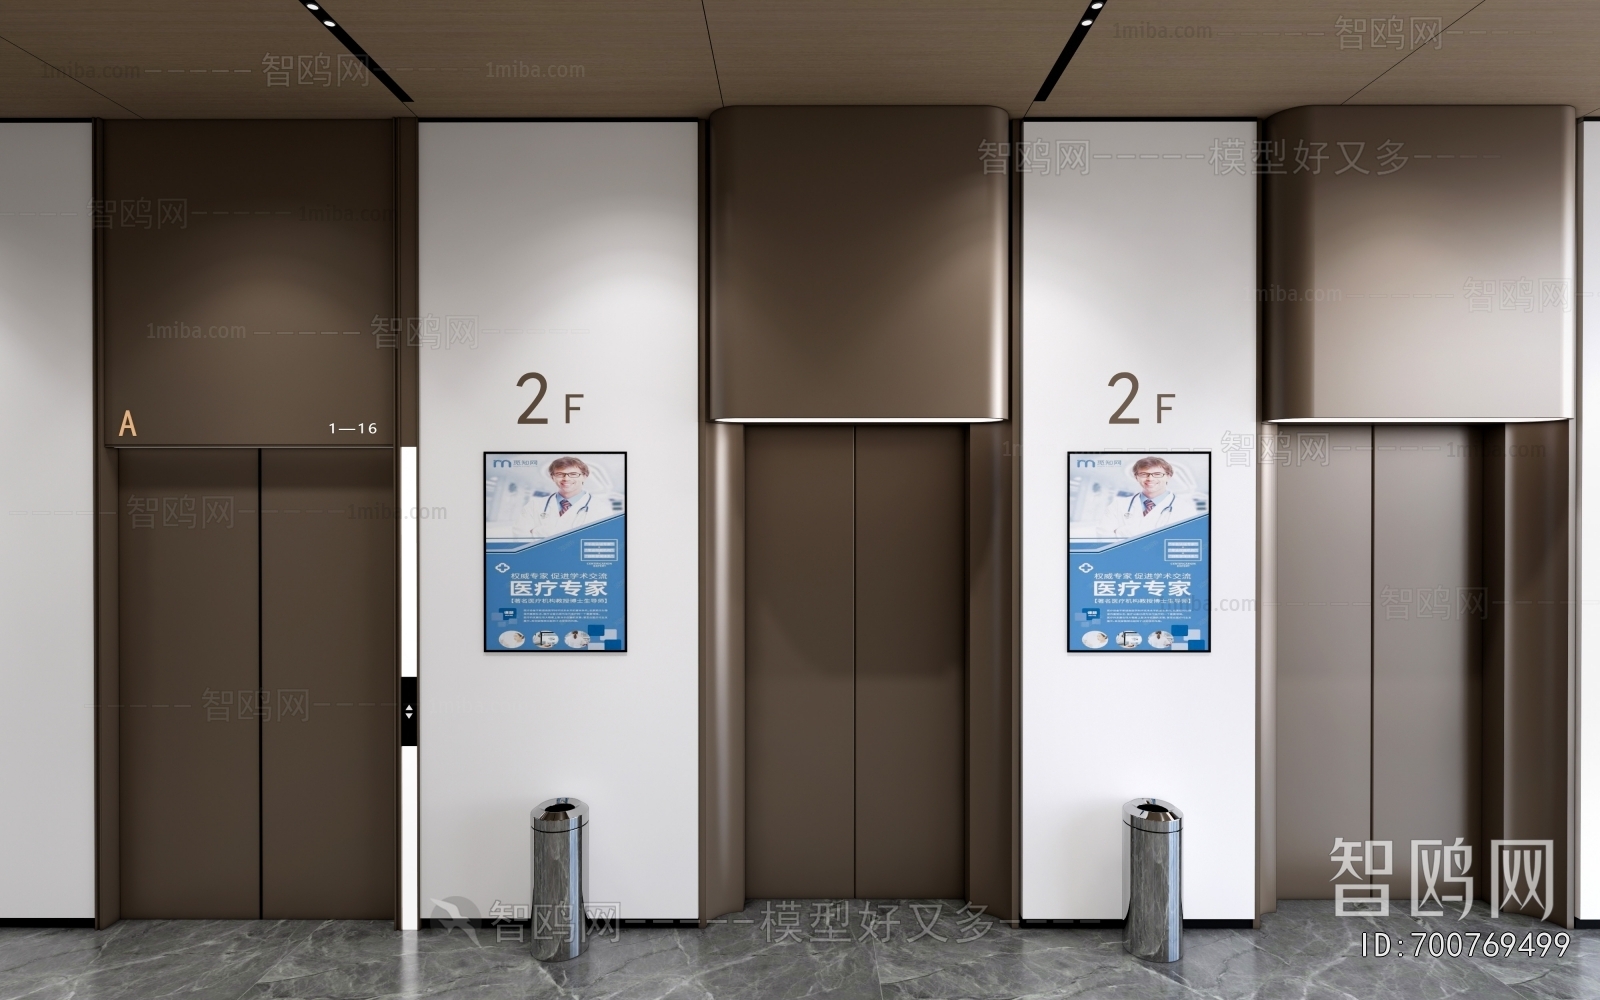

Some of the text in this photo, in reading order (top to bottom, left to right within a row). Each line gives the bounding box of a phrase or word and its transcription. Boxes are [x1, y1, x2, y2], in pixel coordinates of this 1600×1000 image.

[118, 409, 138, 437] A
[510, 580, 608, 597] 医疗专家
[1094, 580, 1192, 597] 医疗专家
